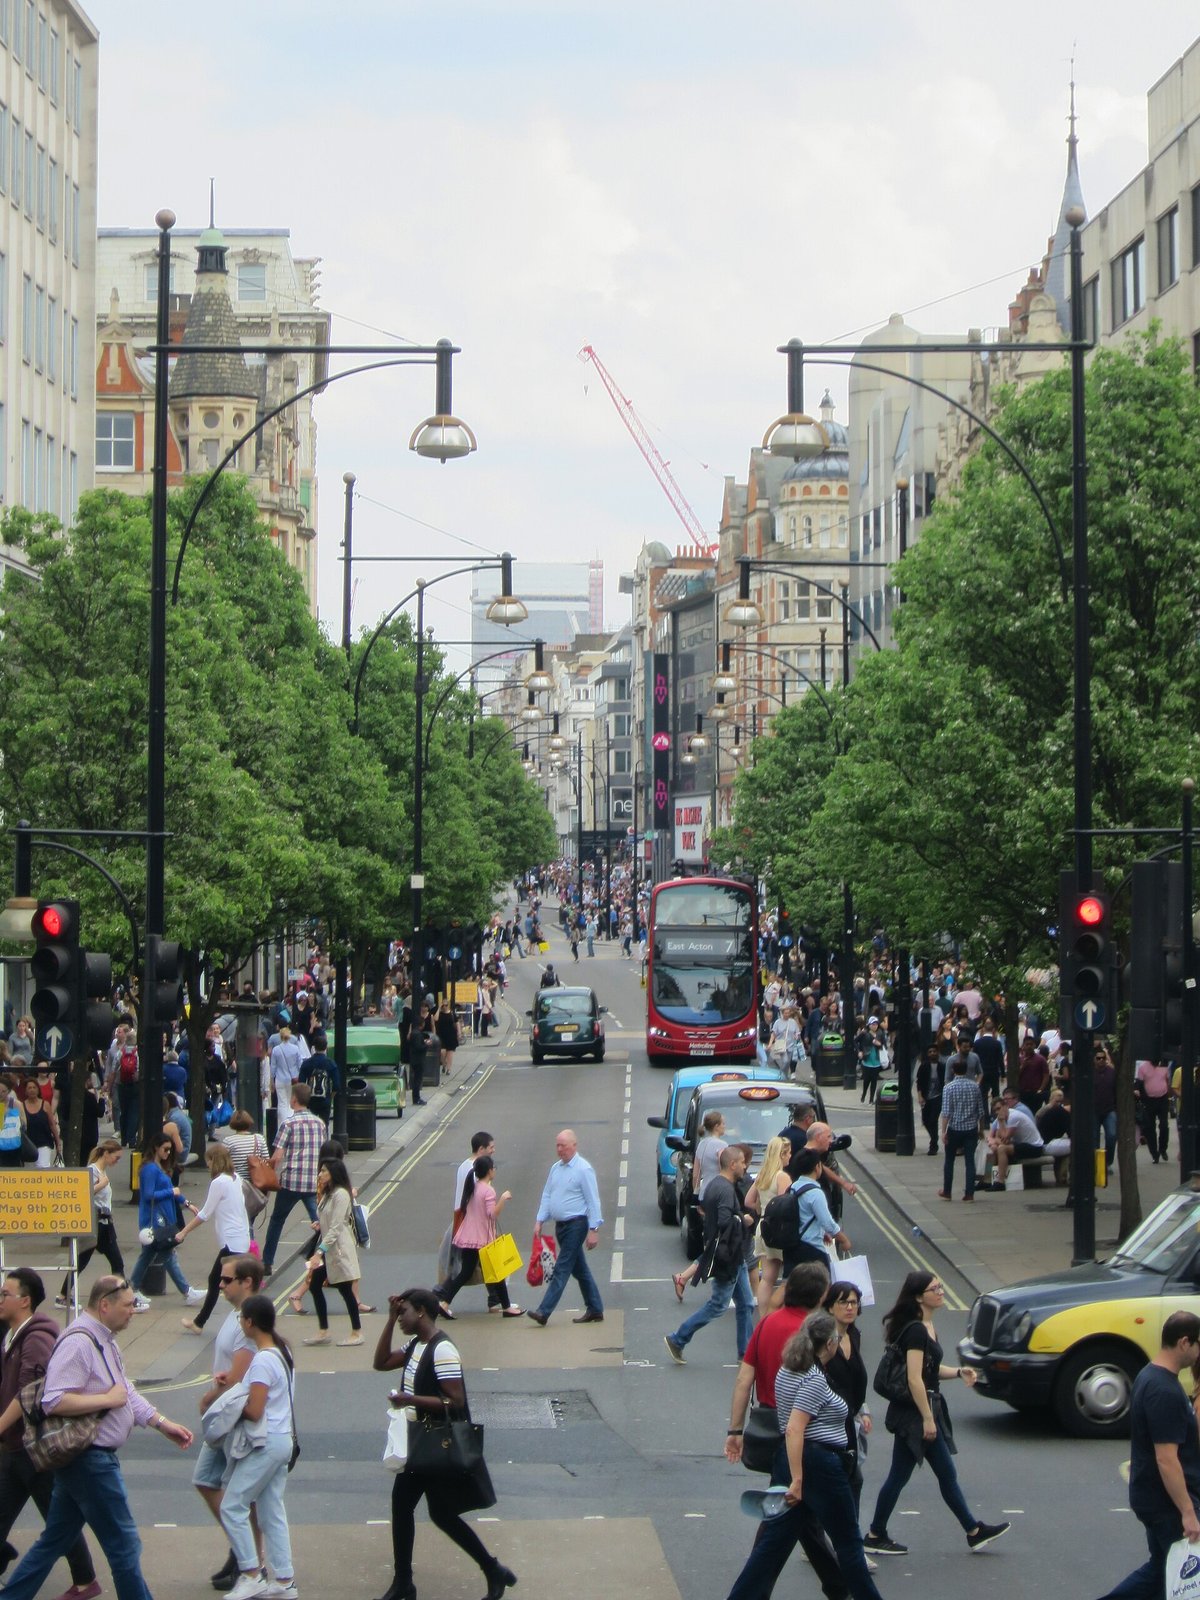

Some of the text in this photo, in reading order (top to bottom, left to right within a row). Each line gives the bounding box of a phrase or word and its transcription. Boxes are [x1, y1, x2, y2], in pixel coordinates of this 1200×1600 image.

[655, 673, 668, 705] hmv
[655, 779, 668, 810] hmv
[667, 940, 735, 953] East Acton 7
[20, 1176, 42, 1184] road
[46, 1176, 63, 1184] will
[67, 1176, 79, 1184] be
[0, 1191, 77, 1199] CLOSED HERE
[0, 1203, 82, 1216] May 9th 2016
[33, 1220, 45, 1230] to
[49, 1220, 88, 1230] 05:00
